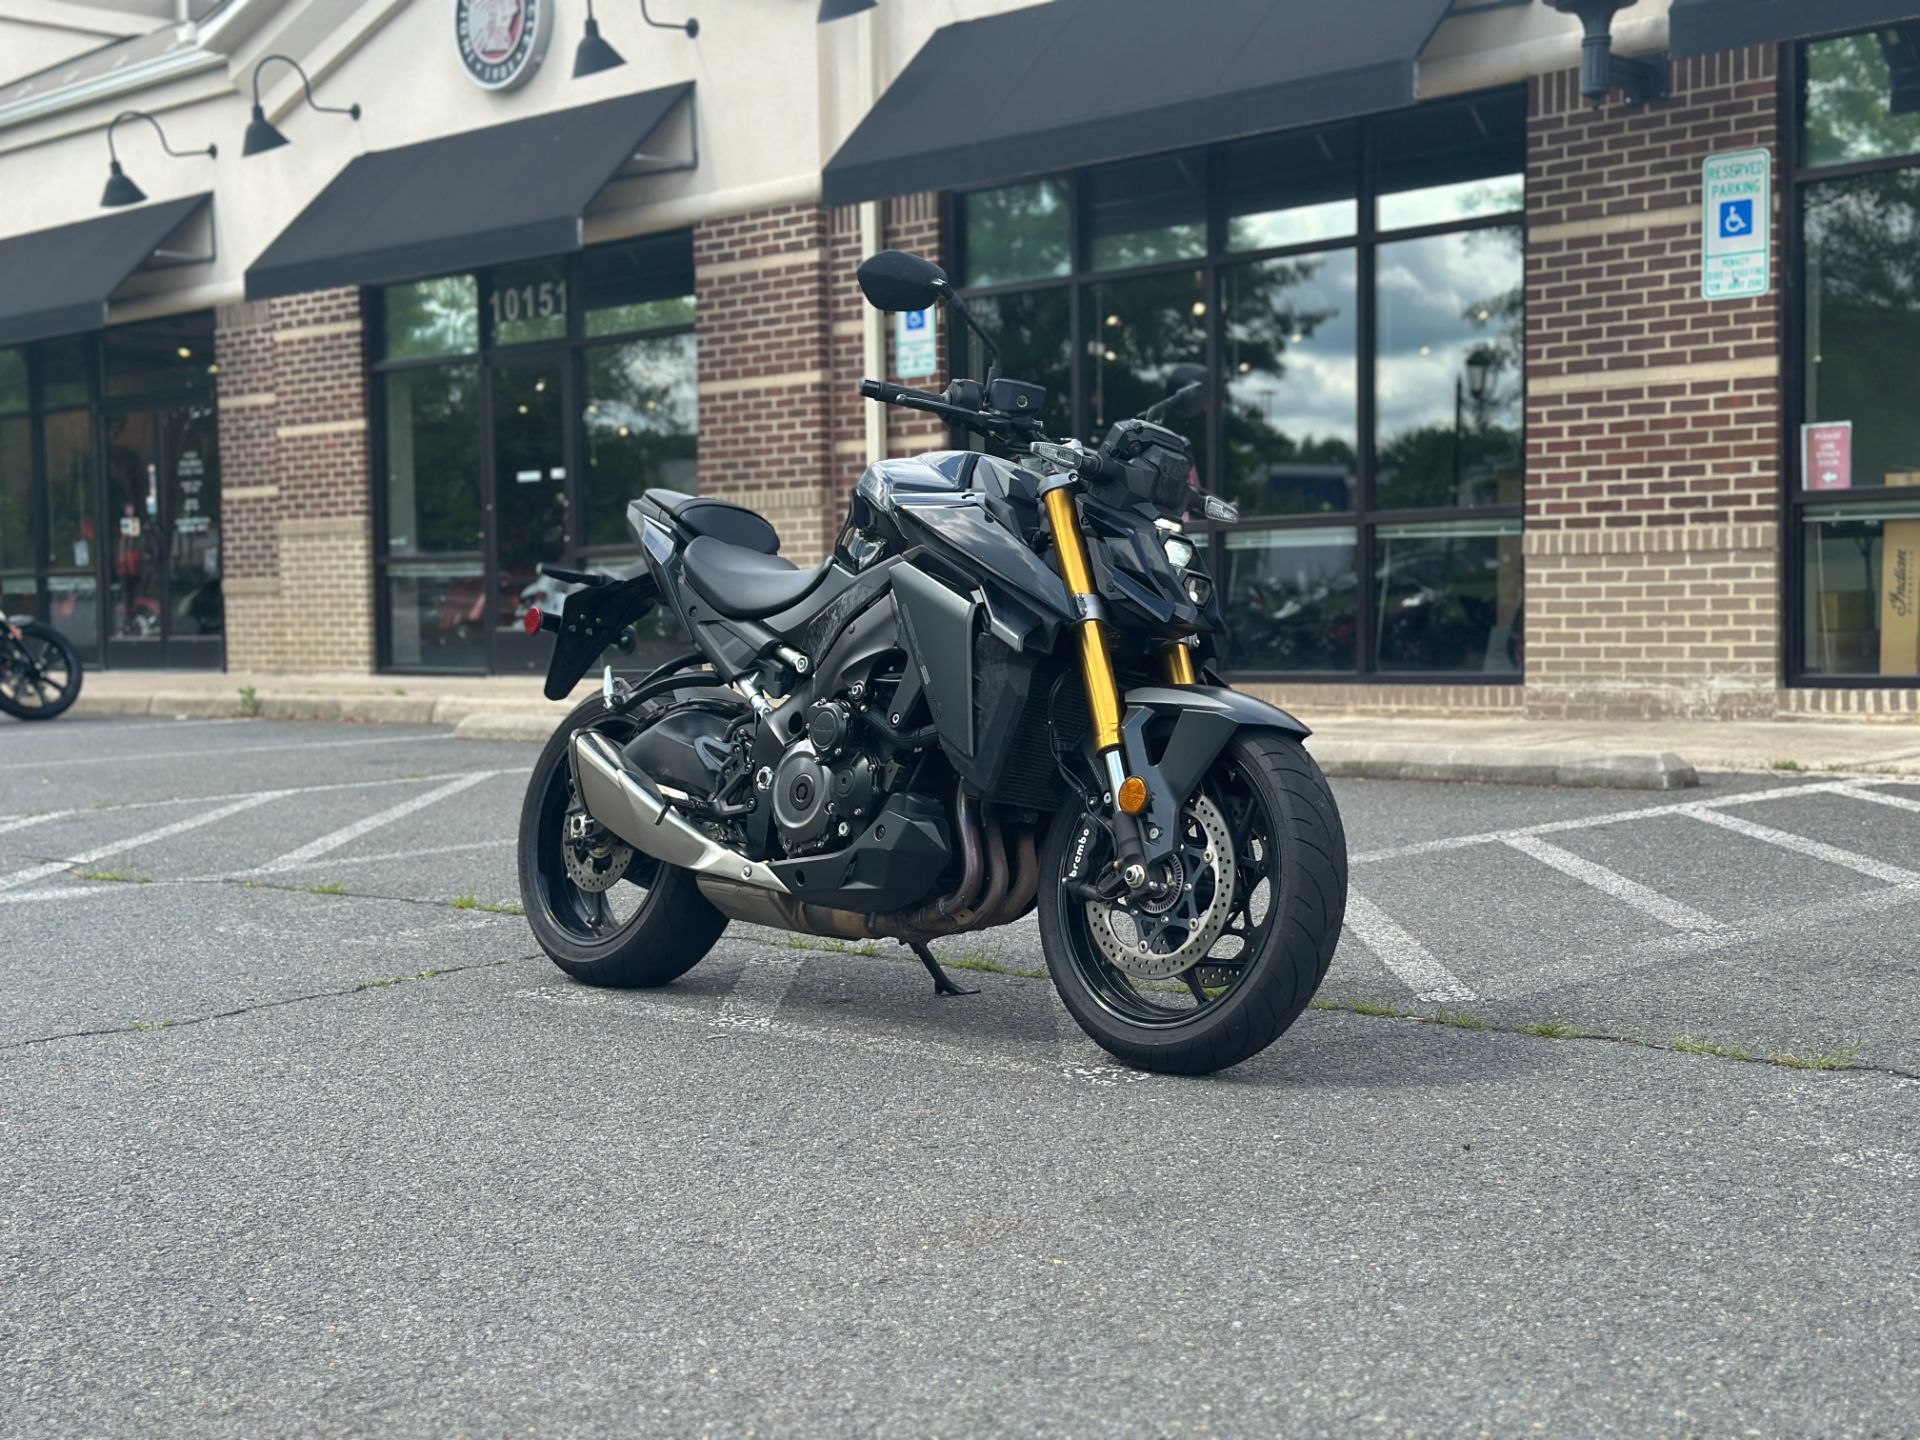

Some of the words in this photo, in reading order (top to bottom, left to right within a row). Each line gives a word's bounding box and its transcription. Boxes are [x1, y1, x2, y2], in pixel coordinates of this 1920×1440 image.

[1707, 161, 1764, 180] RESERVED
[1711, 179, 1761, 198] PARKING
[488, 280, 567, 323] 10151
[1068, 828, 1090, 878] brembo
